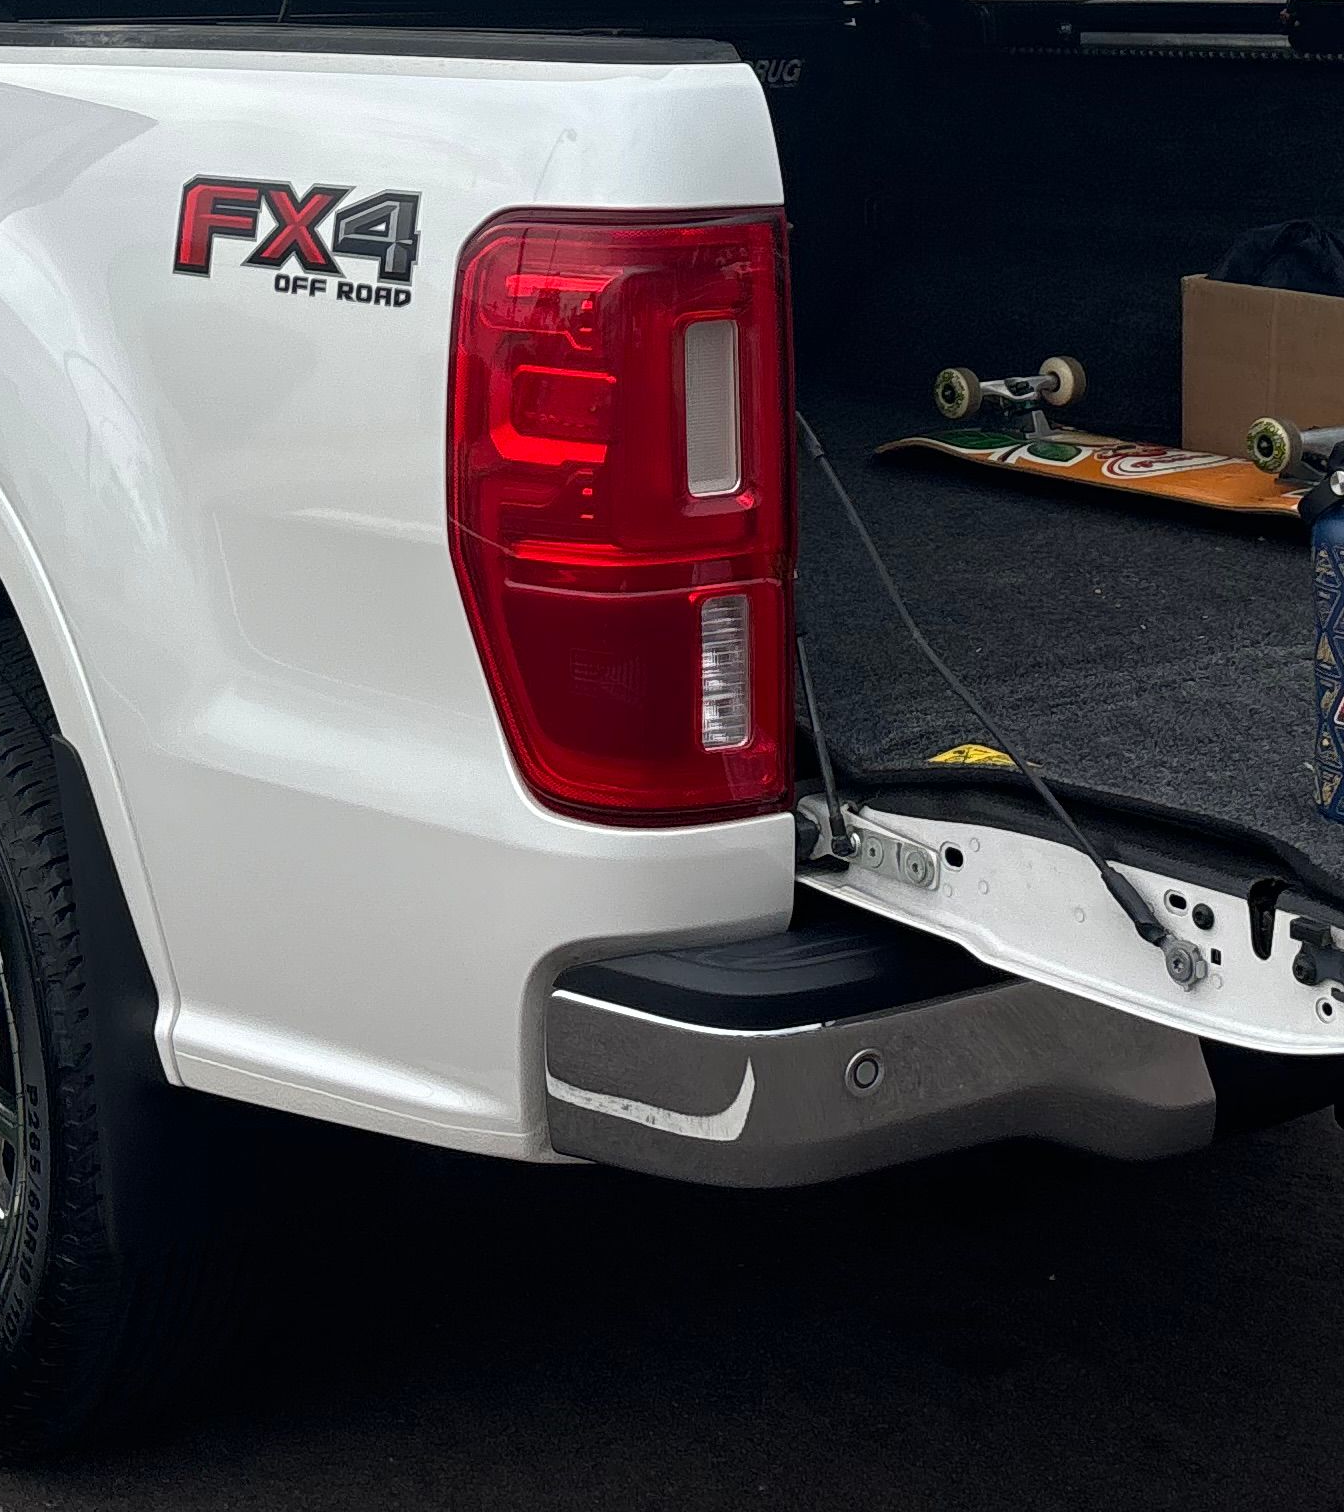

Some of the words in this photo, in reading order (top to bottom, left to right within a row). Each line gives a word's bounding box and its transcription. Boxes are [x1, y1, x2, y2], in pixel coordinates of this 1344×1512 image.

[172, 174, 422, 286] FX4
[274, 273, 327, 298] OFF
[336, 280, 412, 308] ROAD
